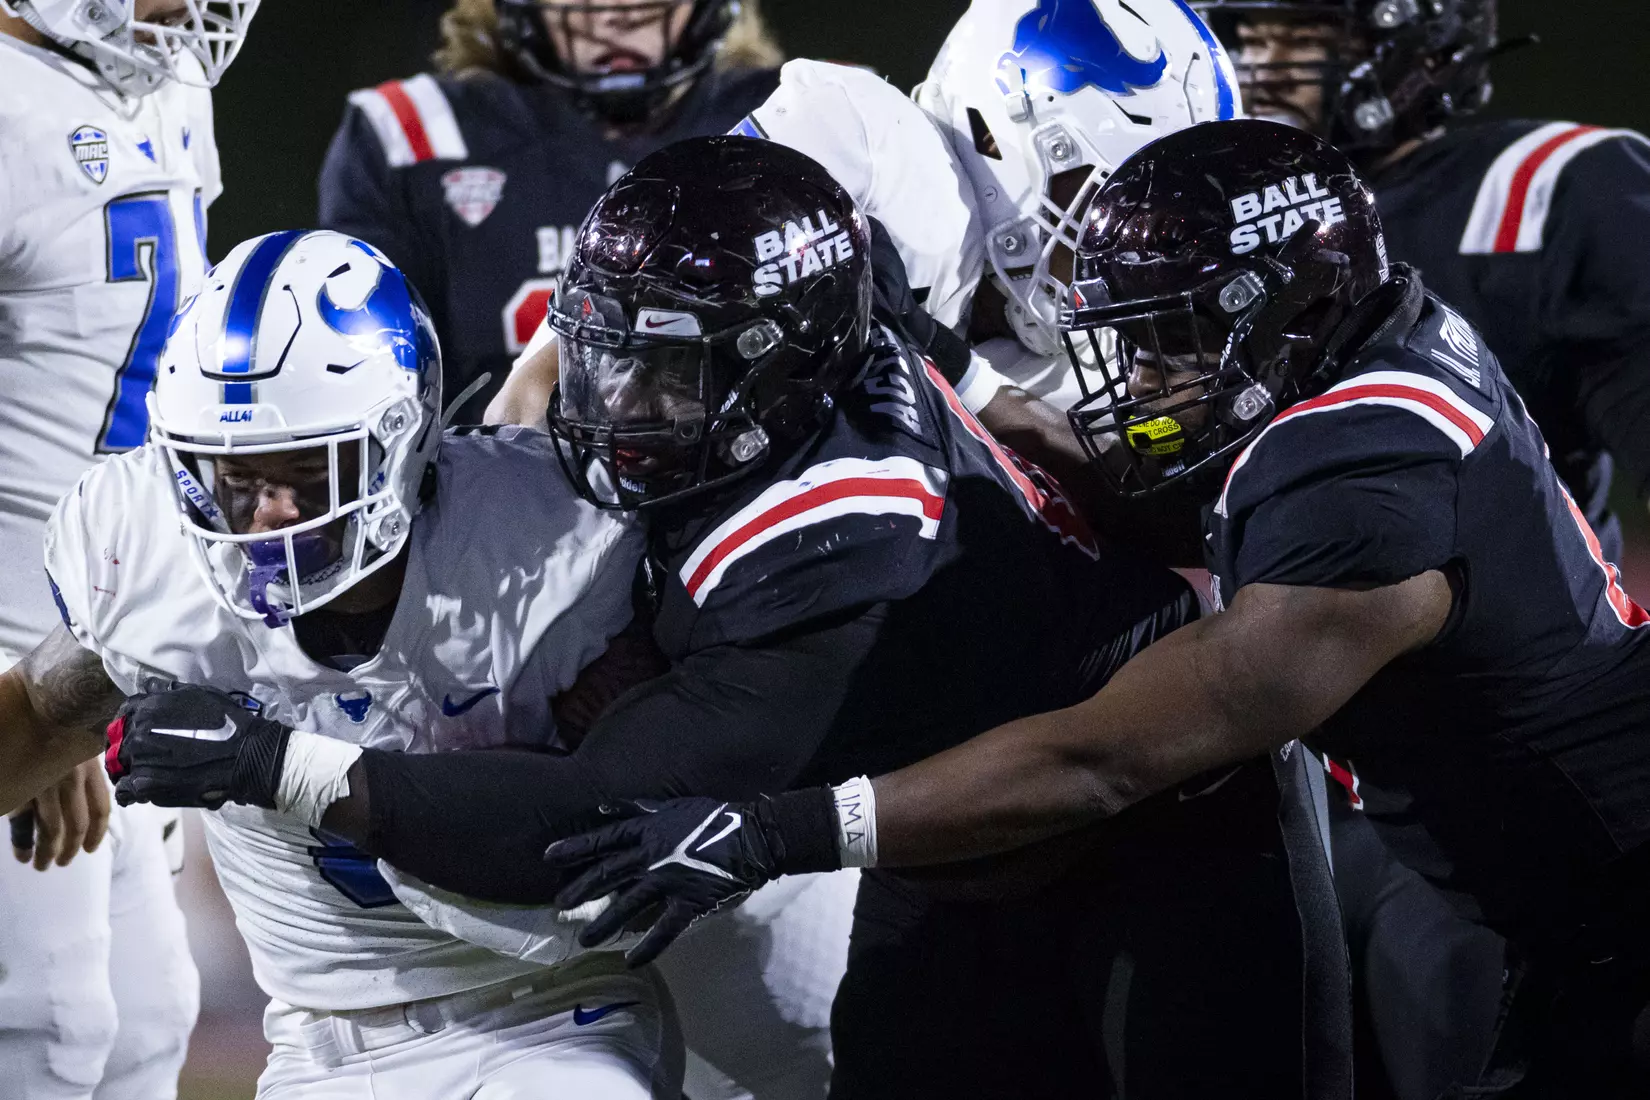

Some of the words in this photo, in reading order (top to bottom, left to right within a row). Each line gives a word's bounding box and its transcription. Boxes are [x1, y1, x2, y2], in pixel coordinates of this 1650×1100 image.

[75, 143, 108, 161] MAC
[1230, 172, 1329, 224] BALL
[754, 209, 839, 263] BALL
[1229, 196, 1346, 256] STATE
[753, 230, 855, 297] STATE
[1153, 424, 1179, 436] CROSS
[175, 469, 209, 512] SPORT
